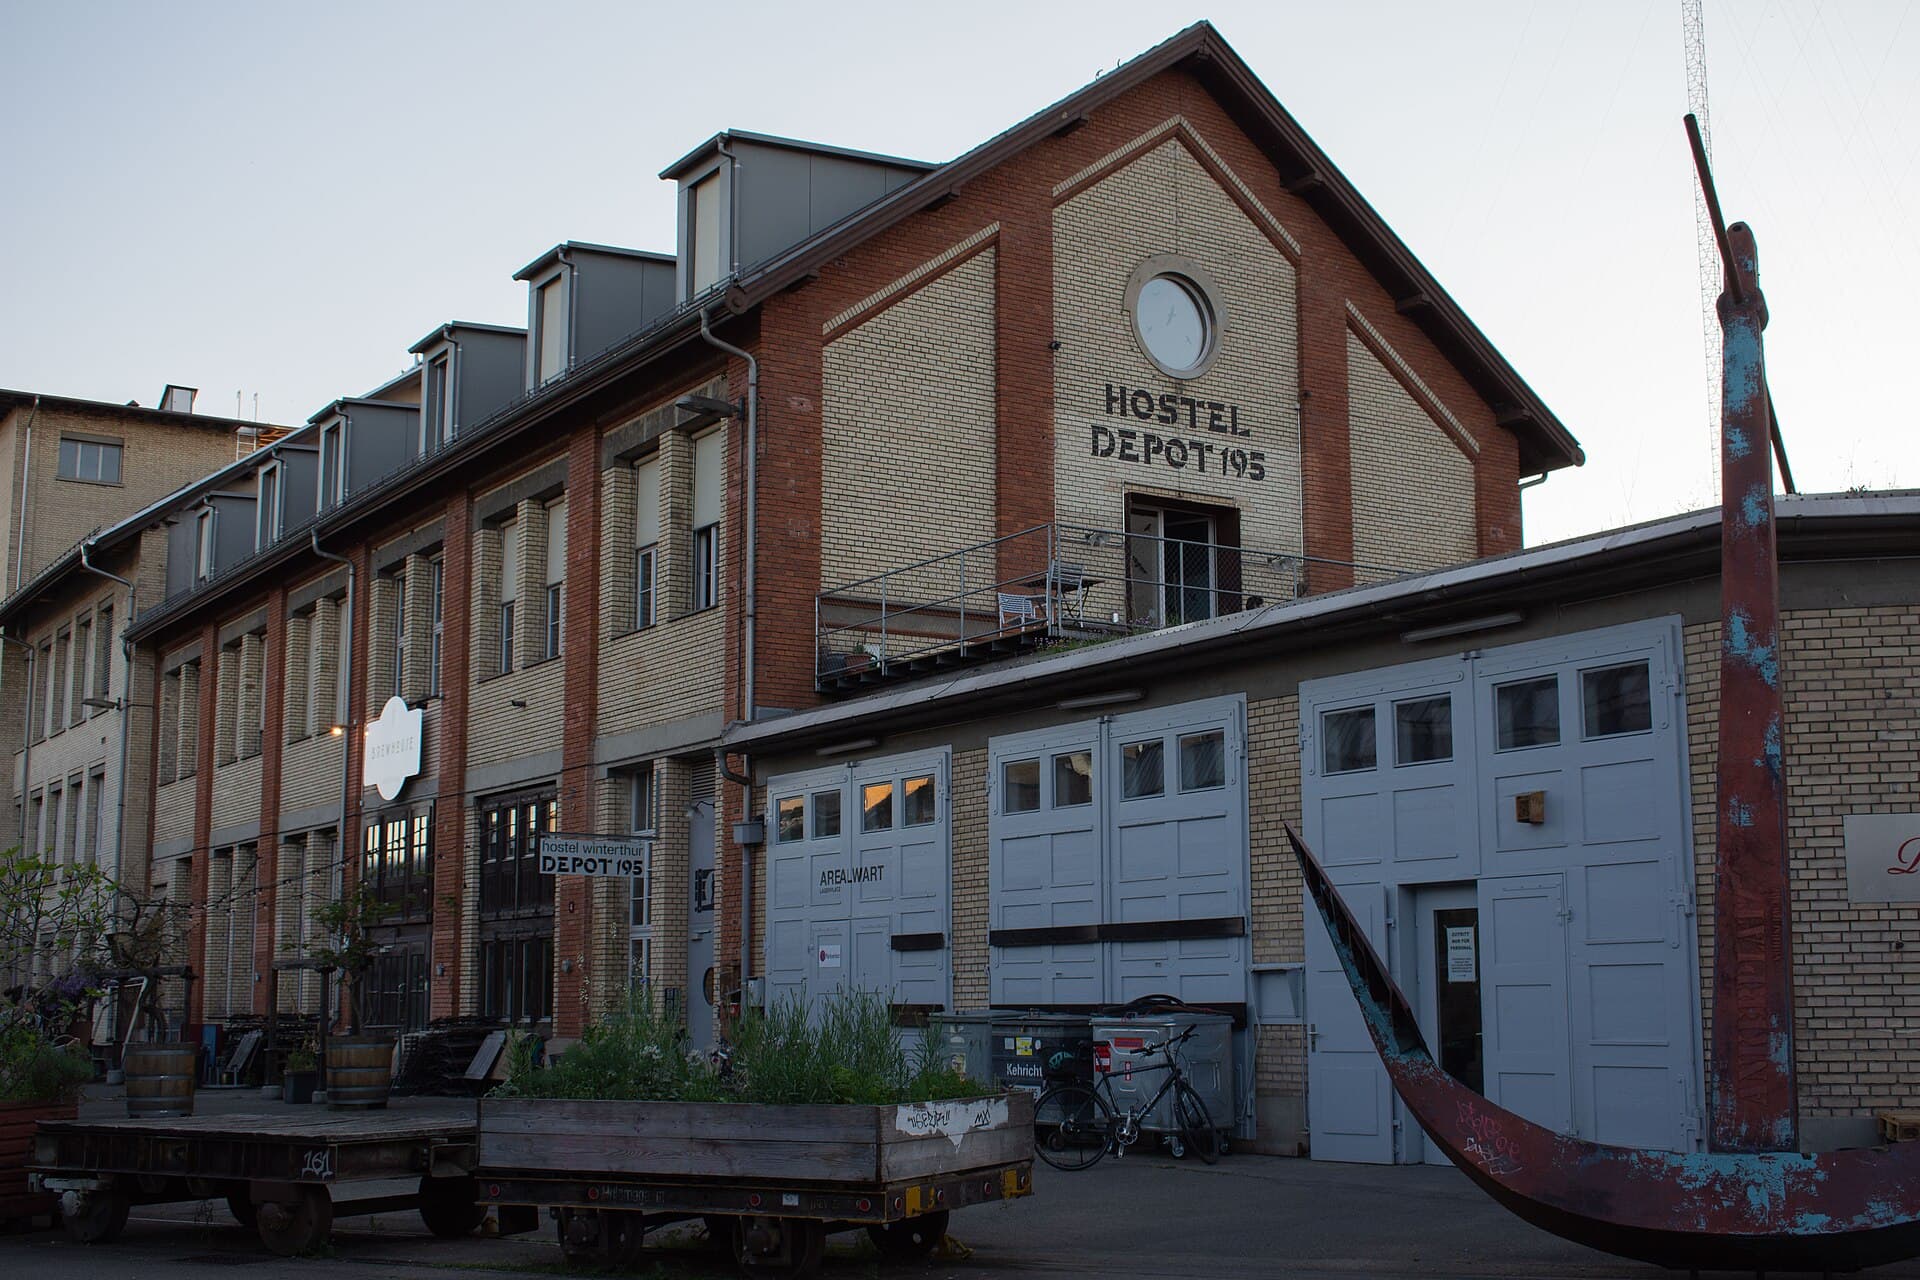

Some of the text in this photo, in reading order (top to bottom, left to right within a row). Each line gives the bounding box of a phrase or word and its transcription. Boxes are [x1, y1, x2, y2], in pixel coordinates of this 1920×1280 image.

[1105, 383, 1250, 437] HOSTEL
[1091, 424, 1265, 481] DEPOT 195
[542, 840, 643, 856] hostel winterthur
[542, 855, 643, 875] DEPOT 195
[820, 865, 885, 886] AREALWART
[1006, 1063, 1043, 1077] Kehricht
